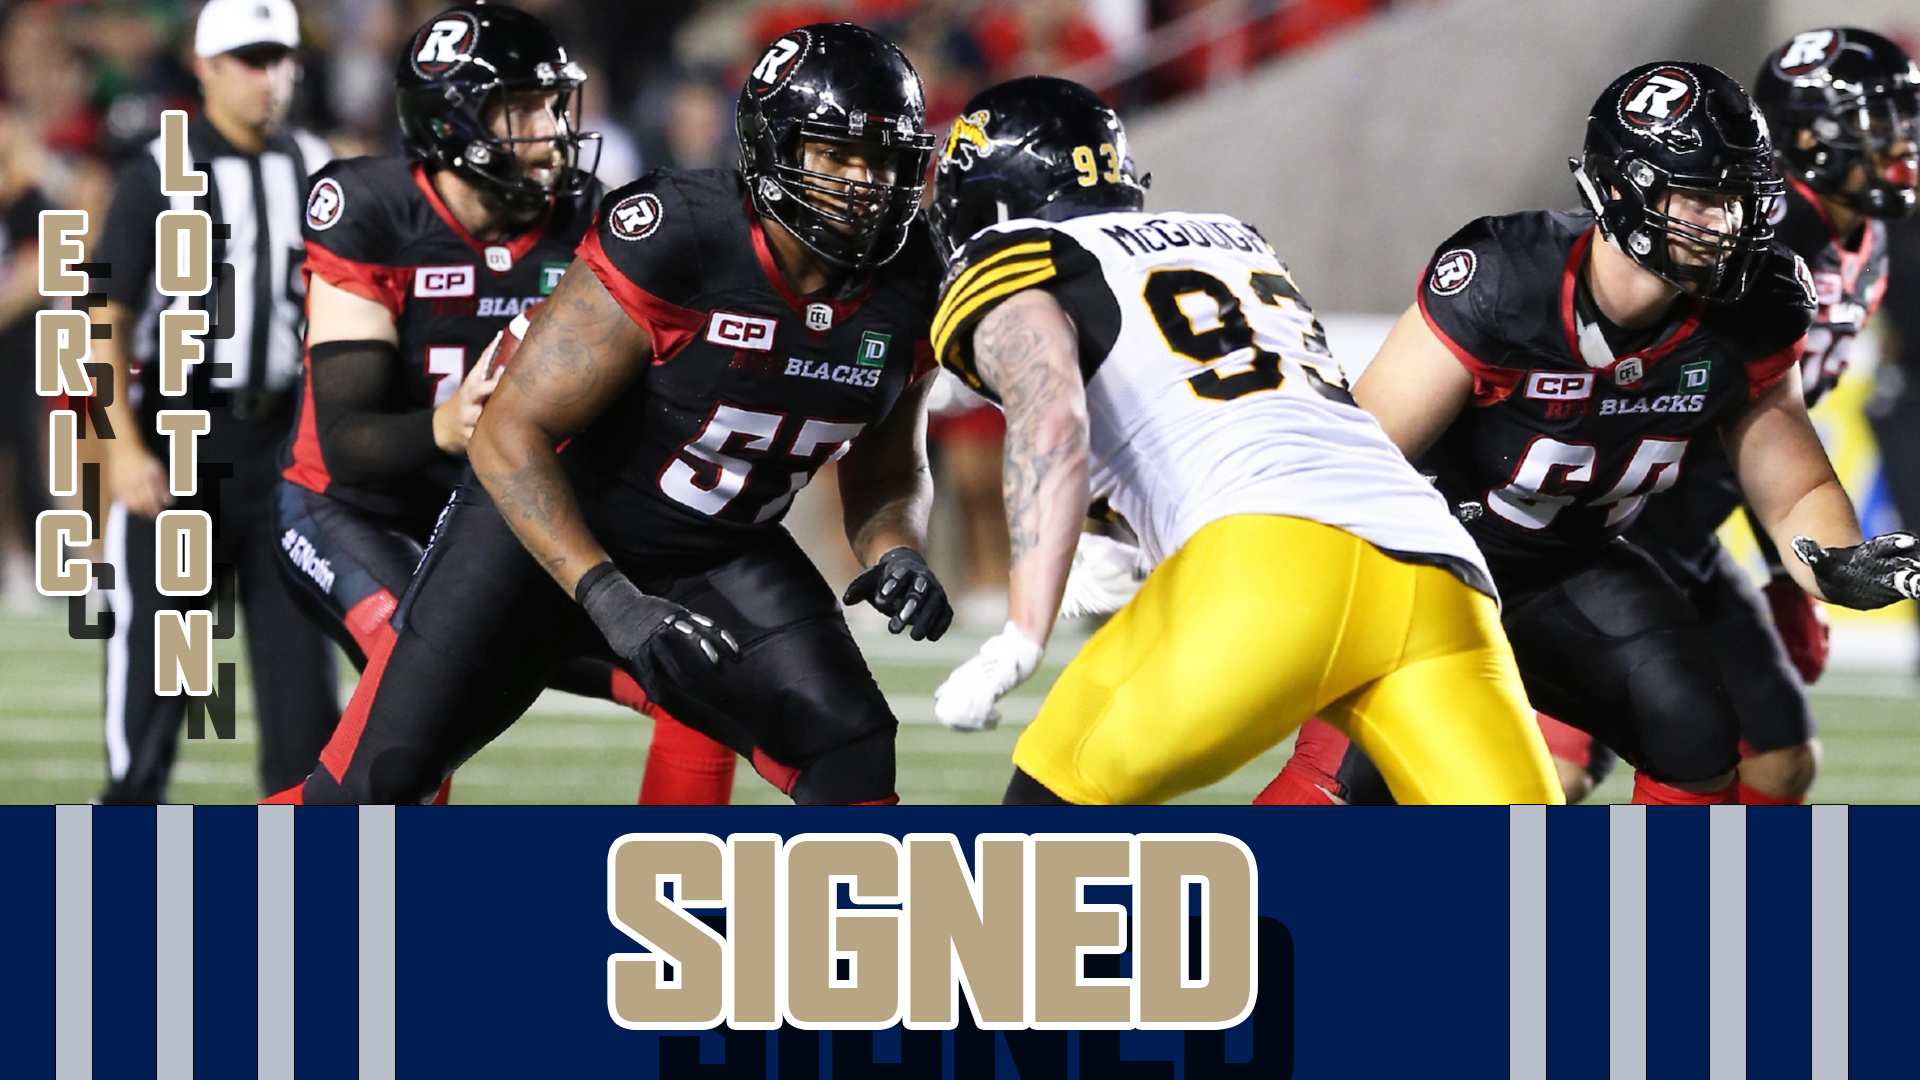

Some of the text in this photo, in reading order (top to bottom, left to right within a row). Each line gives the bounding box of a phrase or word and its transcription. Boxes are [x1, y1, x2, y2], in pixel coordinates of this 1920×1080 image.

[417, 20, 468, 63] R
[753, 38, 800, 85] R
[1625, 75, 1689, 119] R
[1072, 143, 1120, 187] 93
[309, 187, 335, 223] R
[617, 200, 654, 234] R
[425, 273, 465, 290] CP
[1436, 255, 1470, 288] R
[718, 319, 766, 342] CP
[809, 310, 829, 325] CFL
[864, 338, 885, 359] TD
[1141, 265, 1357, 408] 93
[1536, 377, 1585, 395] CP
[1618, 366, 1639, 382] CFL
[1684, 367, 1707, 388] TD
[656, 400, 868, 524] 57
